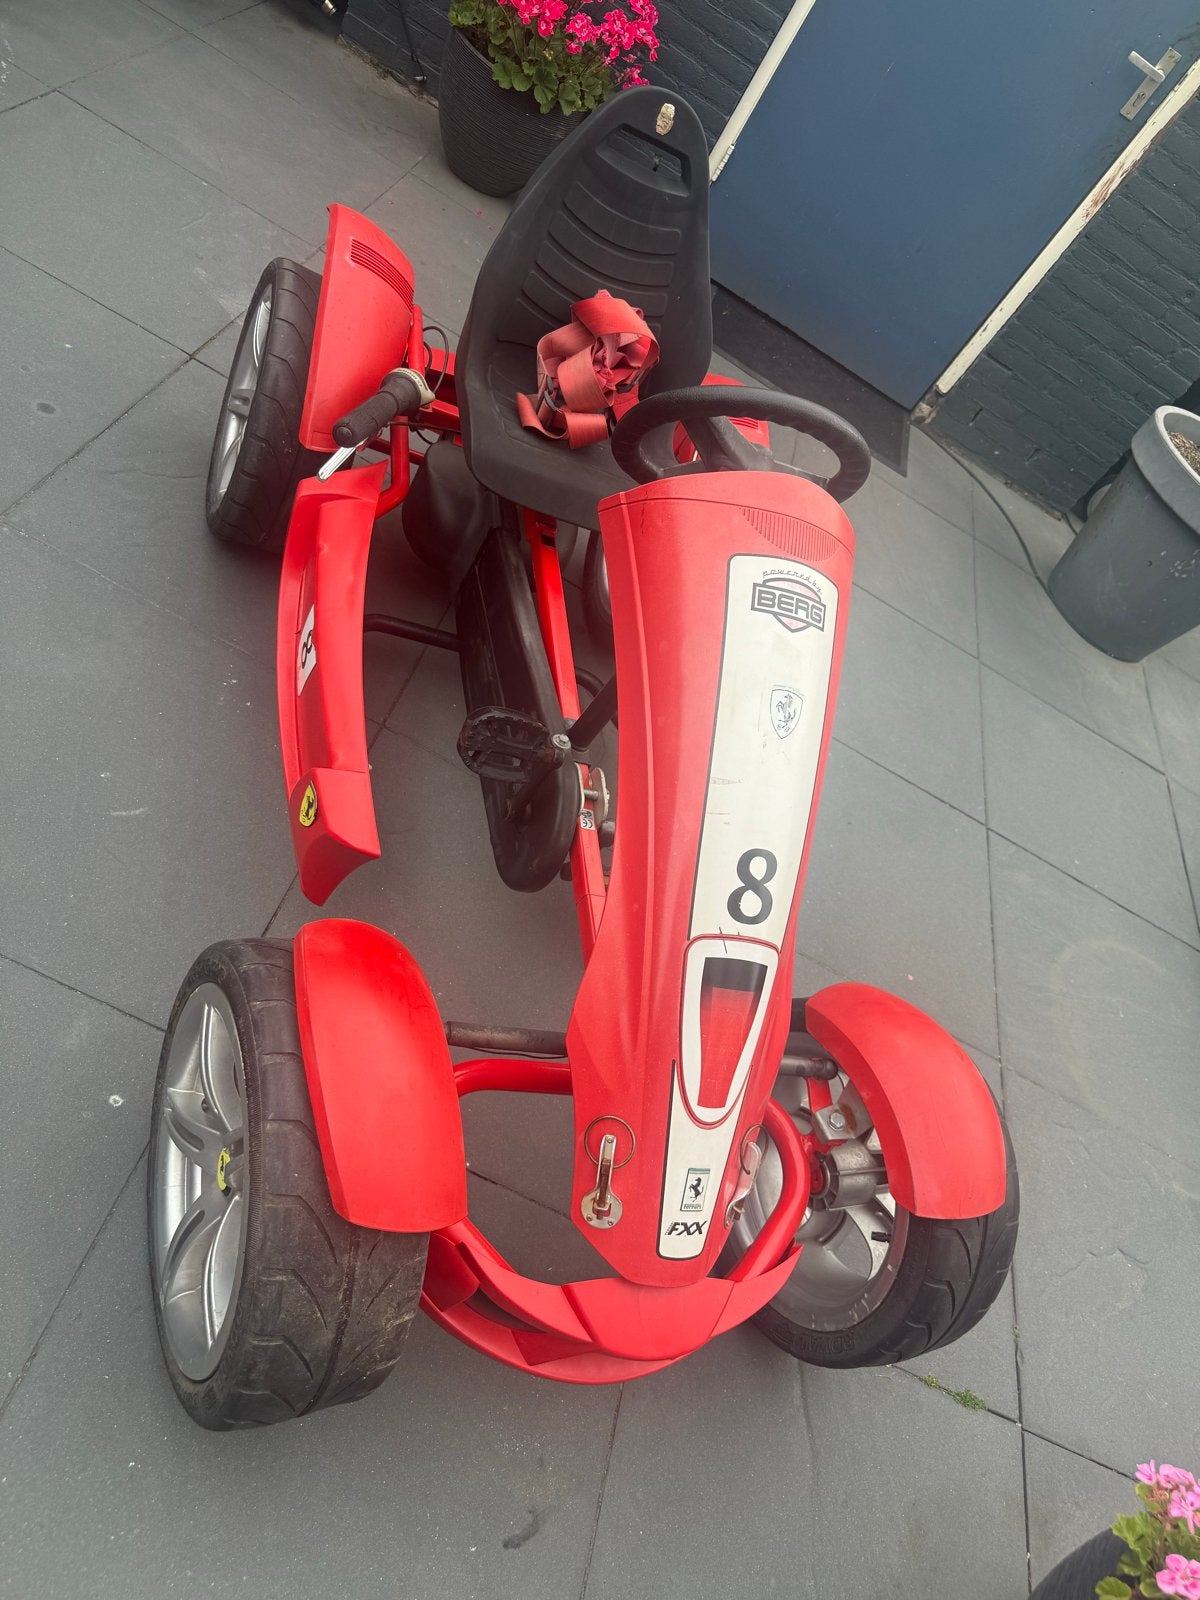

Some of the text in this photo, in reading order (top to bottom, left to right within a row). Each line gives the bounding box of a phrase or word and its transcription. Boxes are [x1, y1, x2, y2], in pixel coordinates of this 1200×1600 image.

[756, 588, 823, 624] BERG
[727, 848, 777, 925] 8
[668, 1220, 707, 1236] FXX
